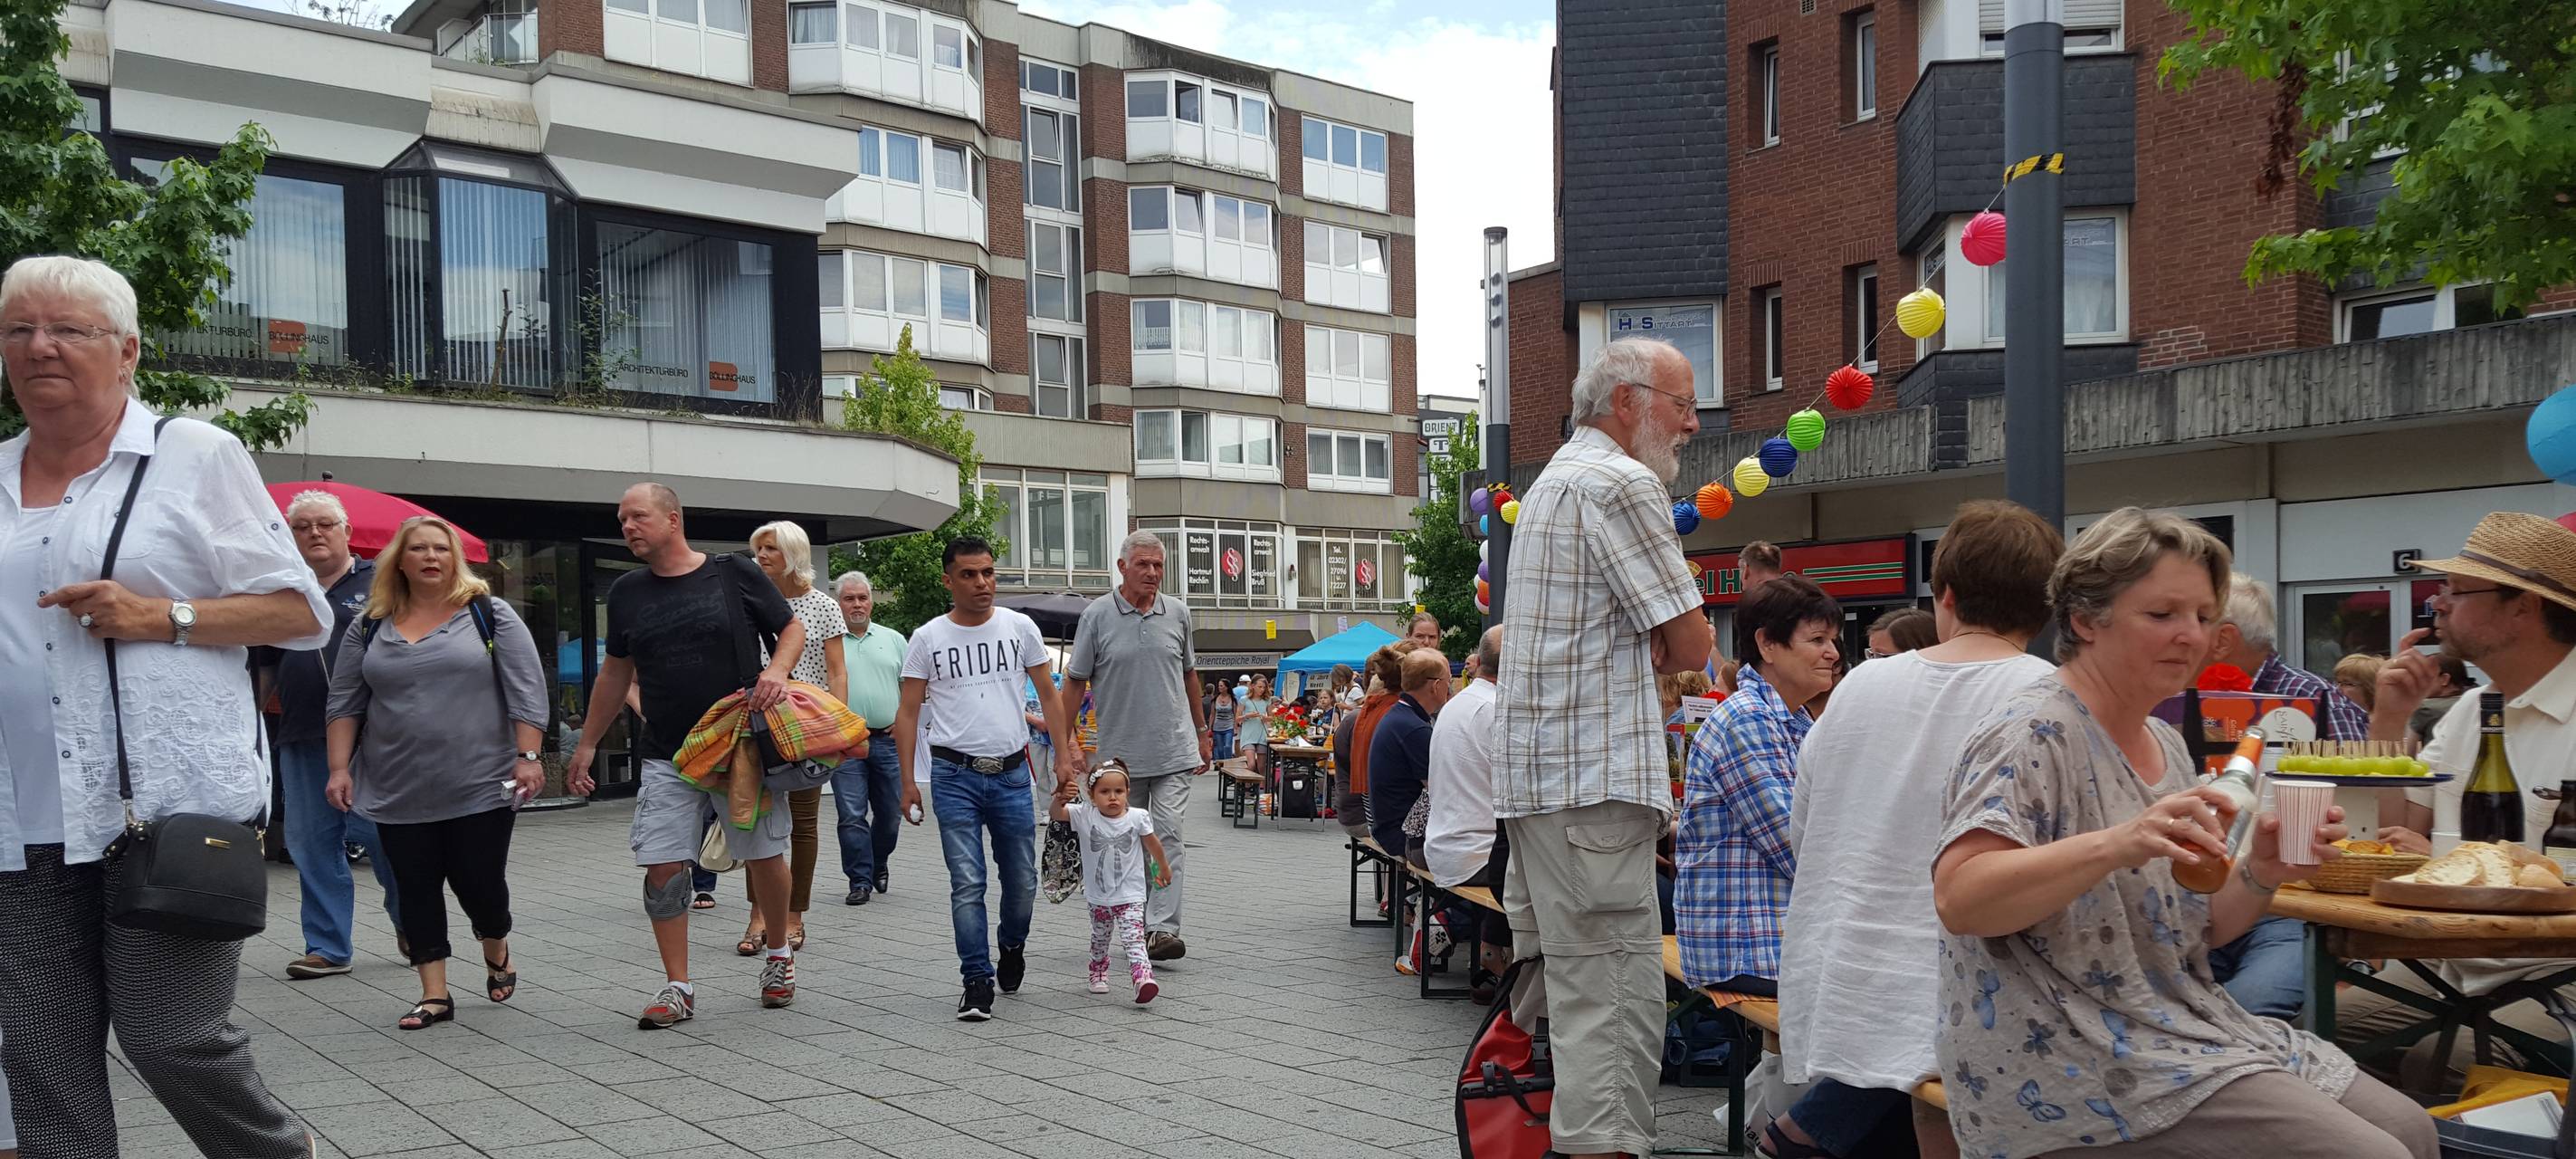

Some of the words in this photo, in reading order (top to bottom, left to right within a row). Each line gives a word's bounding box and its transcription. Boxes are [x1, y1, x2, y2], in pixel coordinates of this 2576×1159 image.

[1189, 536, 1209, 544] Rechts-
[932, 639, 1019, 681] FRIDAY
[1197, 656, 1250, 666] Orientteppiche
[1251, 656, 1270, 666] Royal
